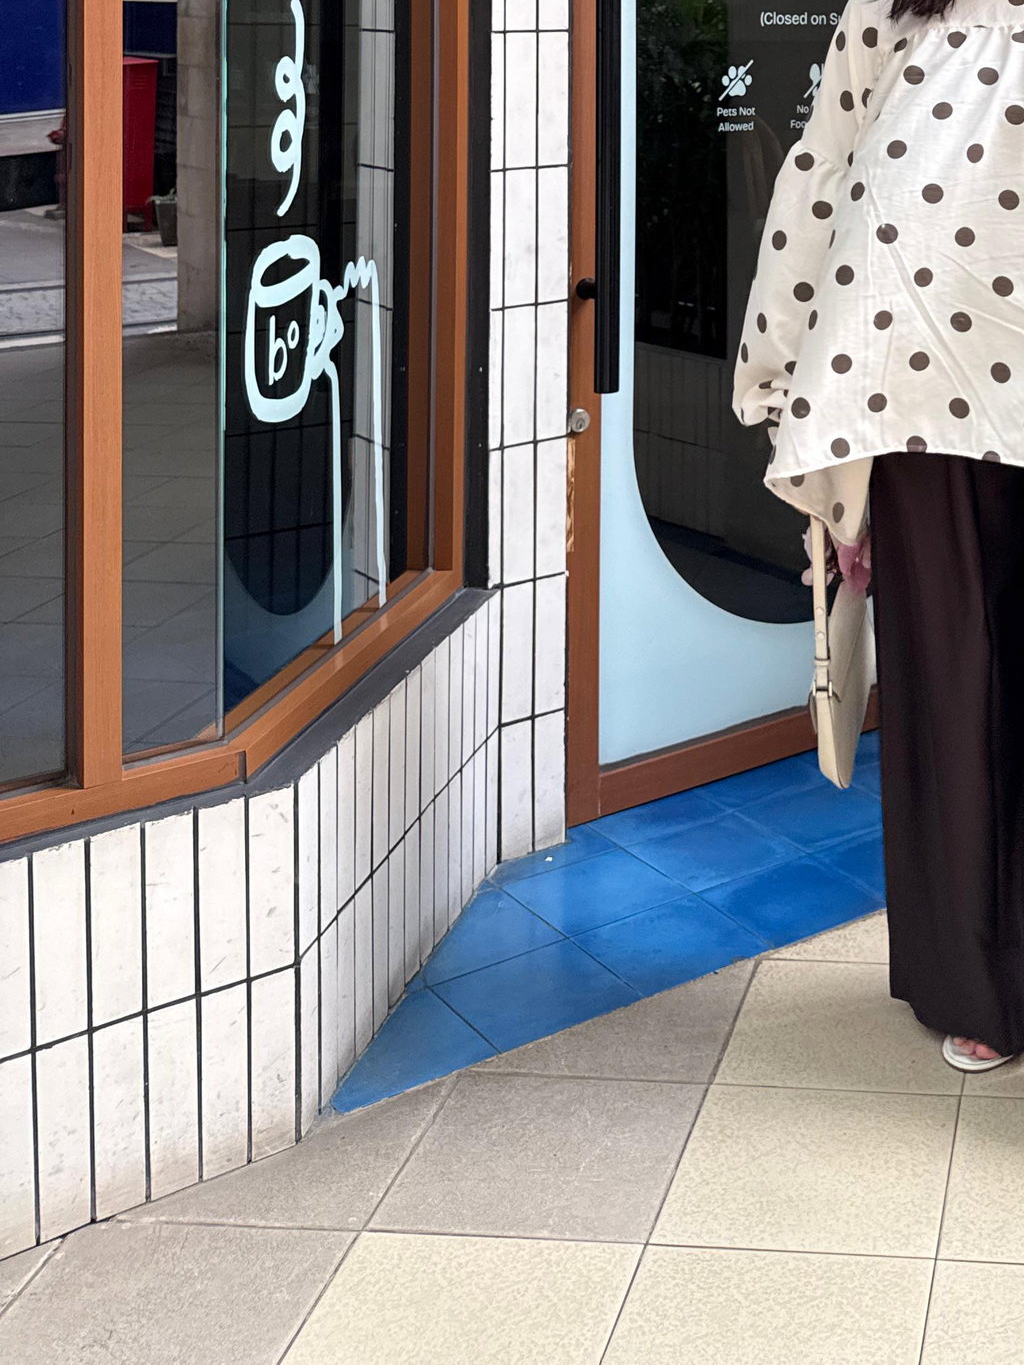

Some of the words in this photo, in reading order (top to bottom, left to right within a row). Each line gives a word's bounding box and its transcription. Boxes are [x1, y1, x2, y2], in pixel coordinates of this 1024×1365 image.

[760, 11, 807, 27] (Closed
[811, 15, 826, 25] on
[716, 107, 737, 117] Pets
[739, 106, 755, 116] Not
[796, 104, 810, 114] No
[718, 121, 754, 132] Allowed
